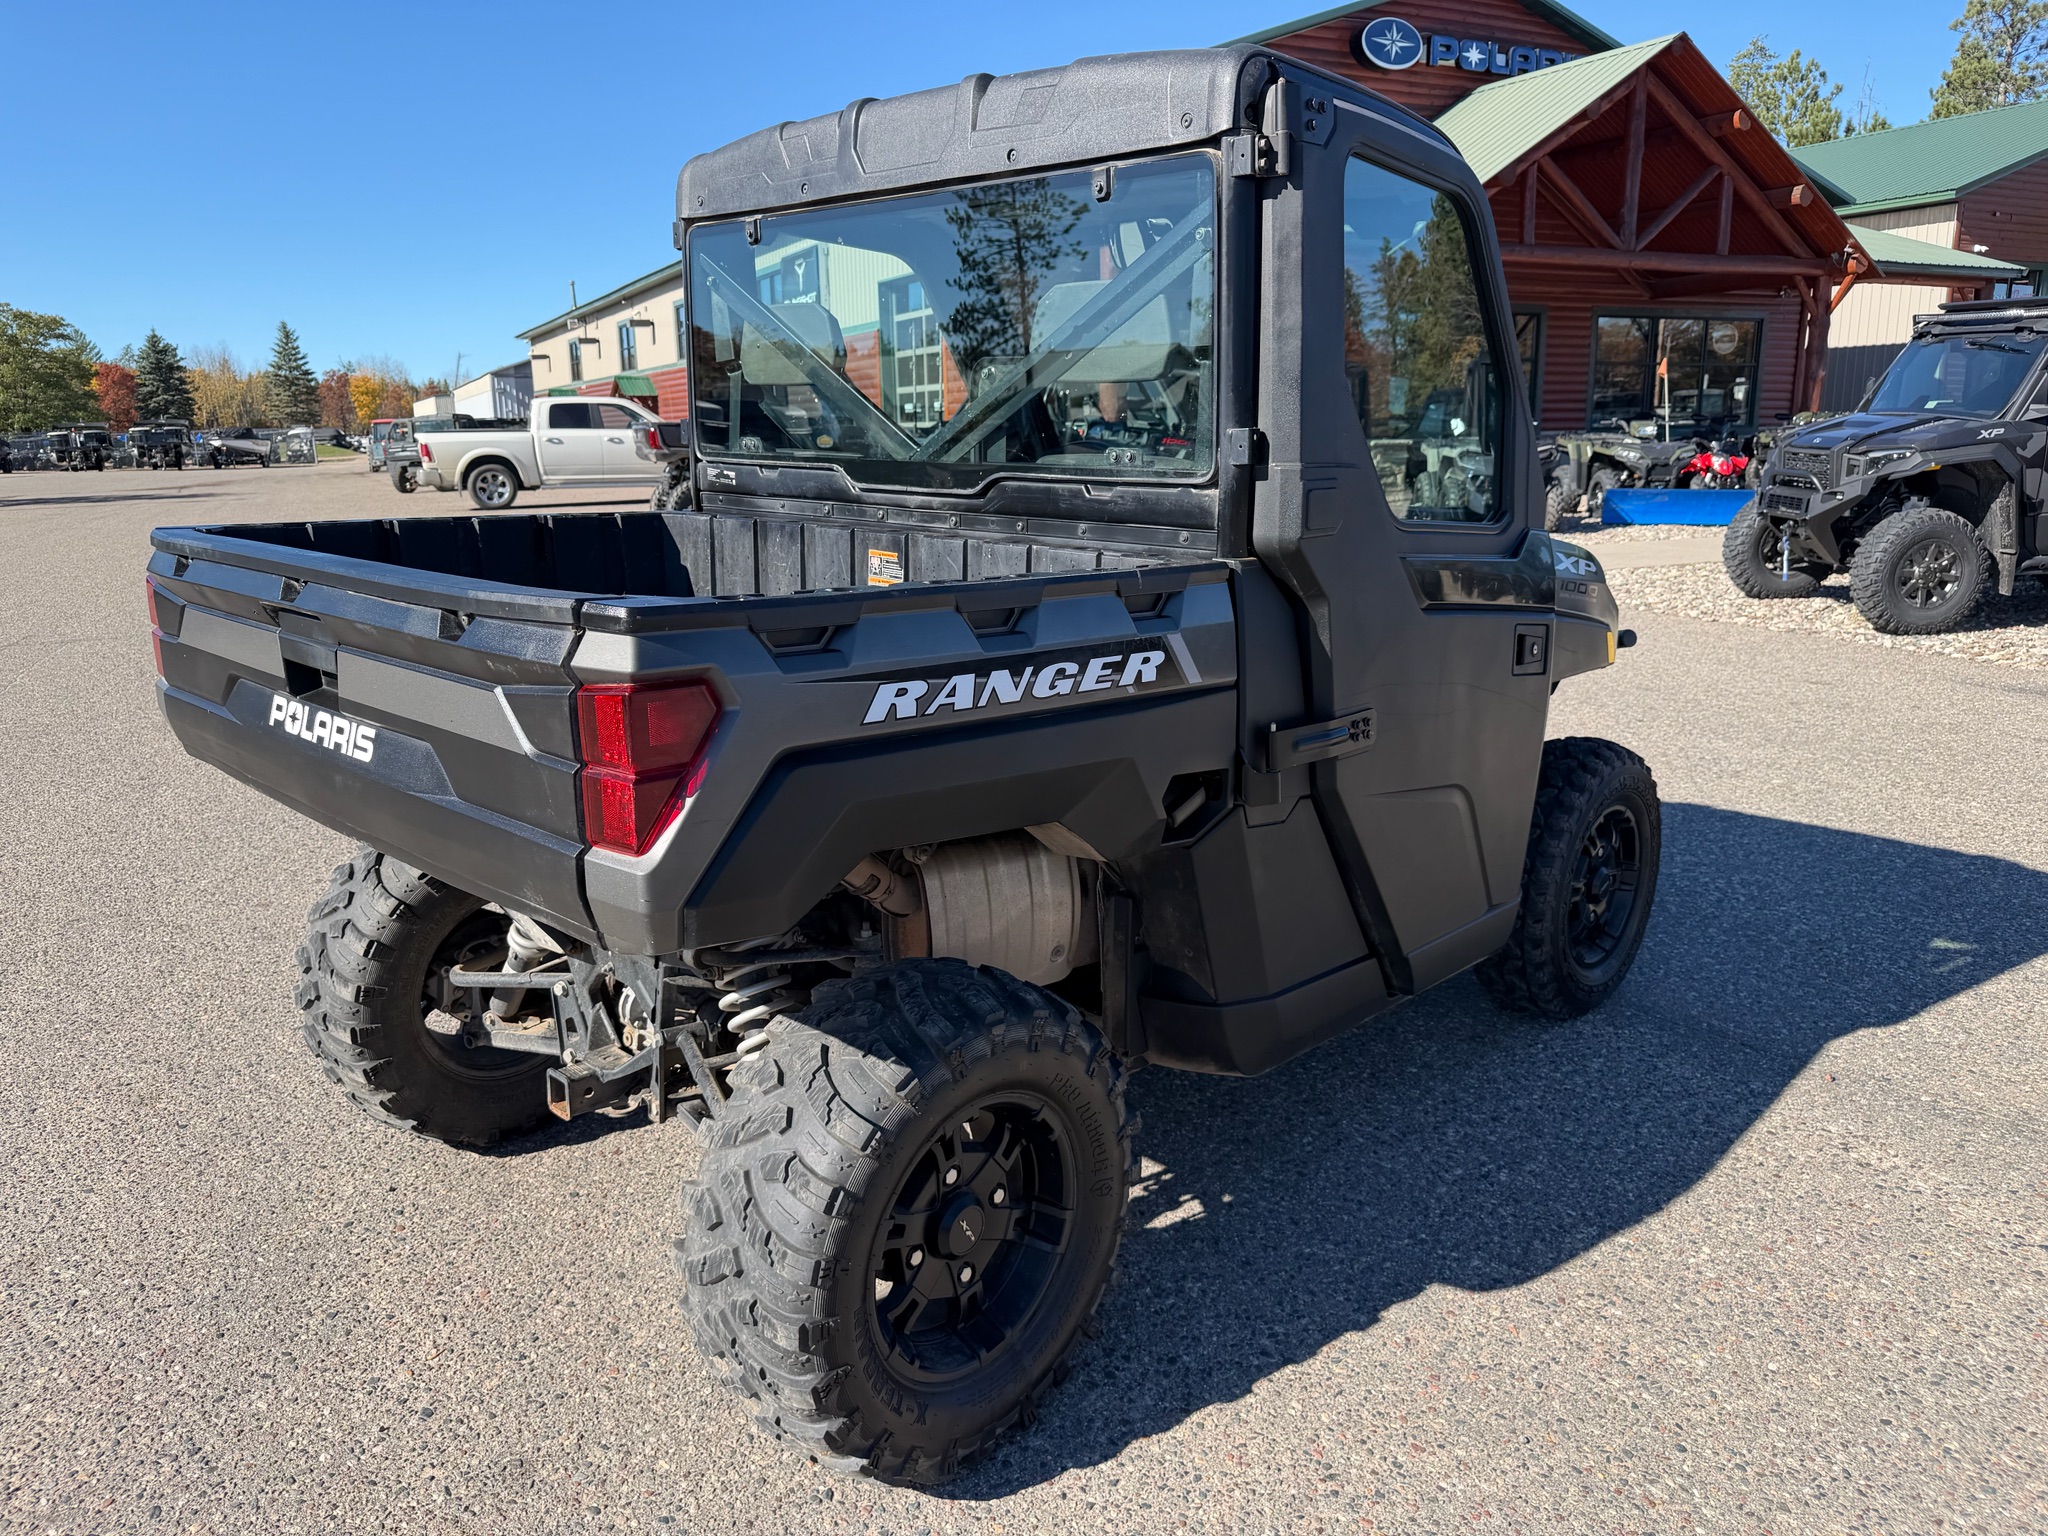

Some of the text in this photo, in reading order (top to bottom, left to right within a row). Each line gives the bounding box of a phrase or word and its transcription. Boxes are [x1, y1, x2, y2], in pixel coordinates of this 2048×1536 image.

[1430, 35, 1588, 76] POLAR
[1976, 428, 2005, 439] XP
[1555, 552, 1597, 576] XP
[1560, 580, 1598, 597] 1000
[861, 650, 1166, 726] RANGER
[268, 694, 376, 763] POLARIS
[1048, 1072, 1114, 1177] PRO ARMOR
[959, 1219, 976, 1241] XP
[853, 1304, 929, 1427] X-TERRAIN
